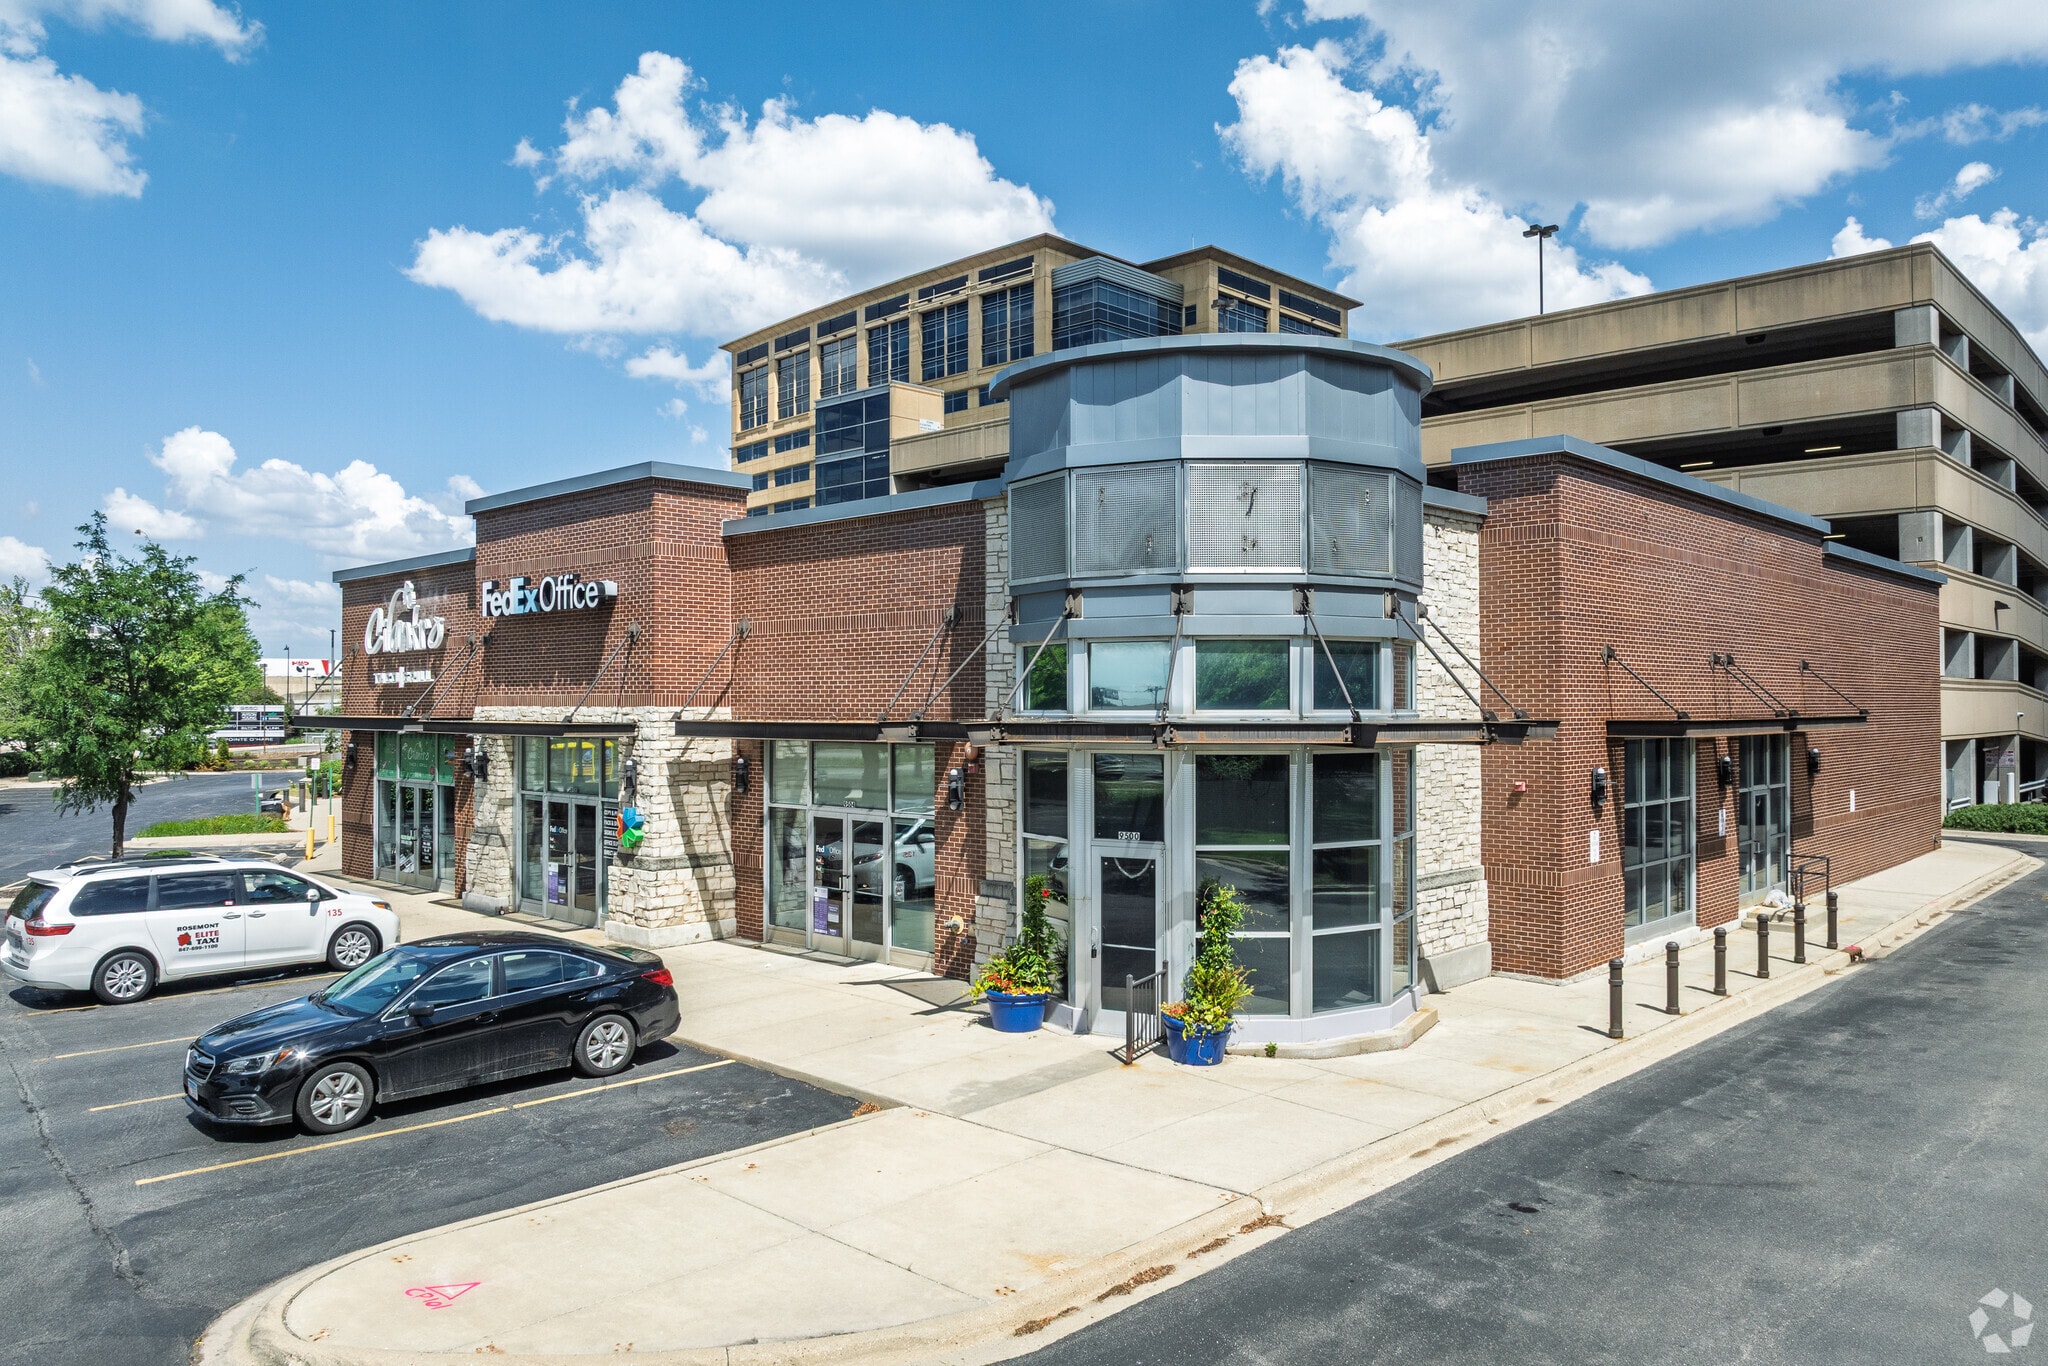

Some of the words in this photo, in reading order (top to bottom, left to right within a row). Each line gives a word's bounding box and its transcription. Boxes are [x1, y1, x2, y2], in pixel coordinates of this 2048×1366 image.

[482, 576, 538, 617] FedEx
[540, 574, 599, 612] Office
[327, 908, 343, 917] 135
[177, 923, 219, 932] ROSEMONT
[195, 930, 219, 938] ELITE
[196, 937, 219, 945] TAXI
